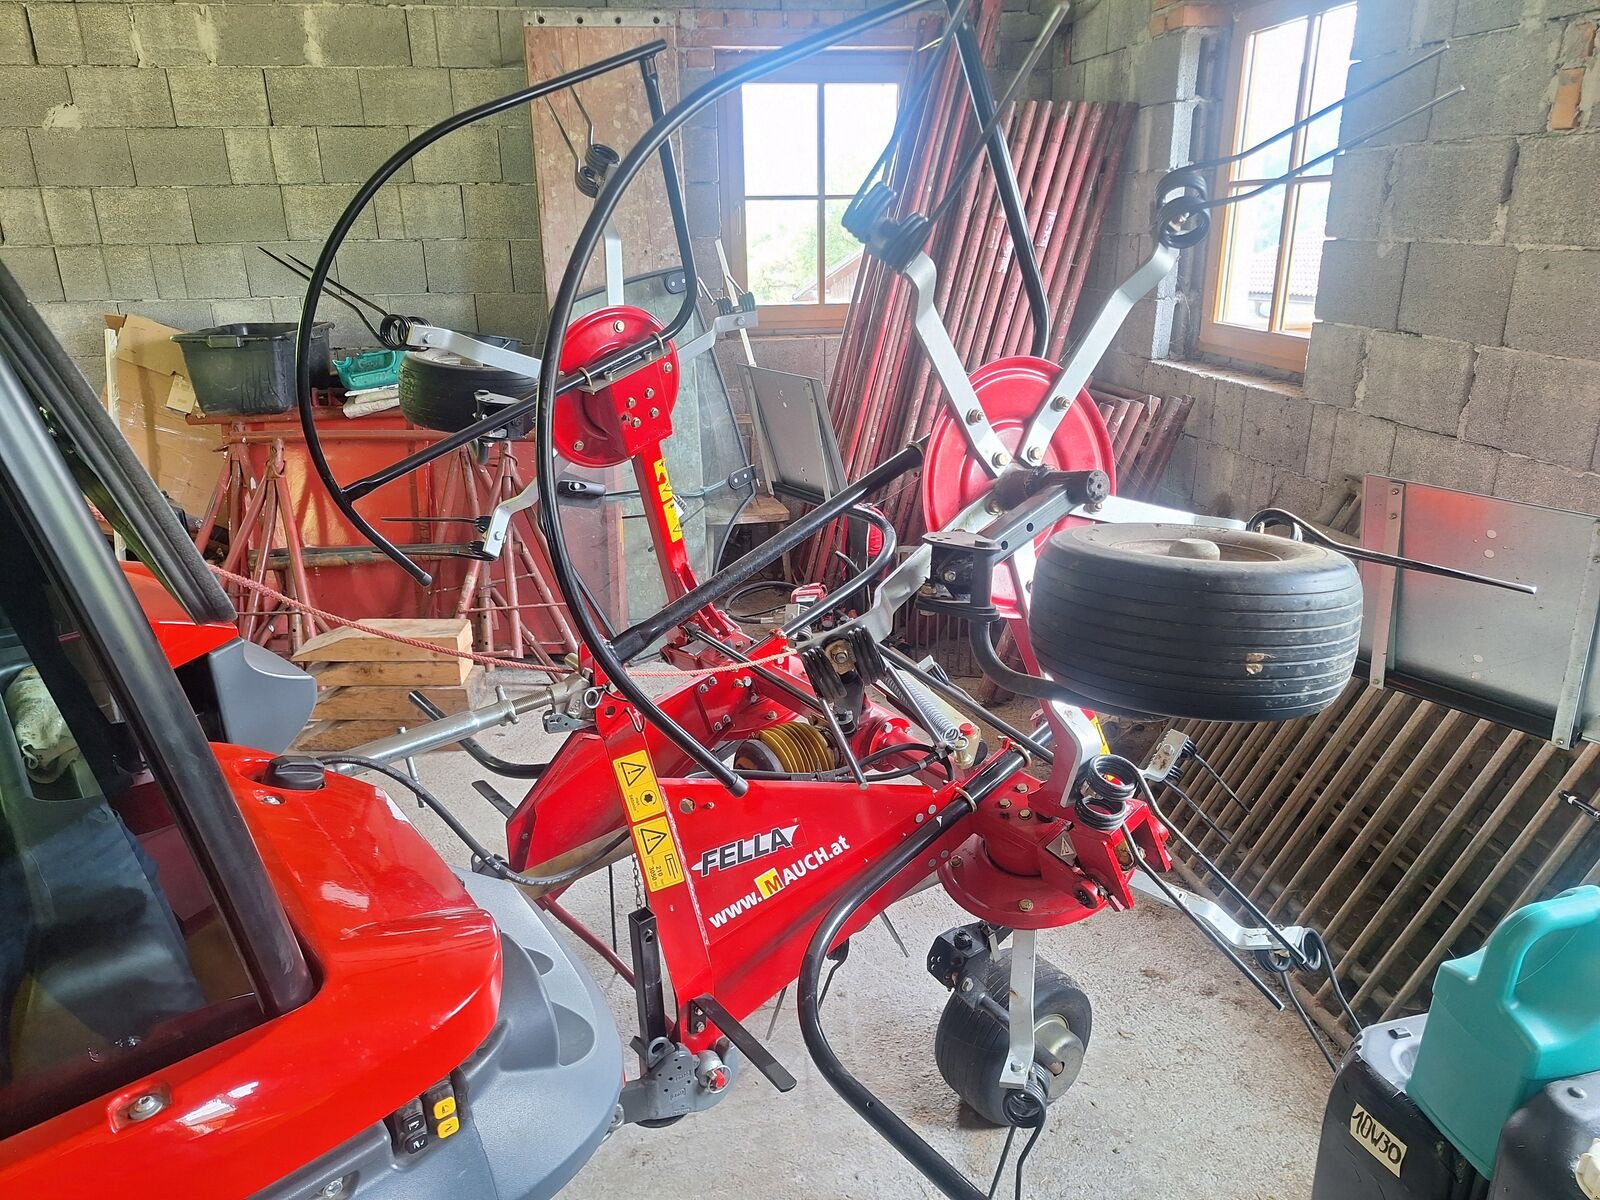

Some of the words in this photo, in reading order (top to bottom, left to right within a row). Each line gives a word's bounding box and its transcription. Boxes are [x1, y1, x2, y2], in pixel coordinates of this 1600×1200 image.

[648, 865, 658, 881] 3050
[655, 865, 664, 877] 210
[701, 827, 792, 877] FELLA
[708, 835, 851, 929] www.MAUCH.at
[1351, 1110, 1402, 1165] 10W30
